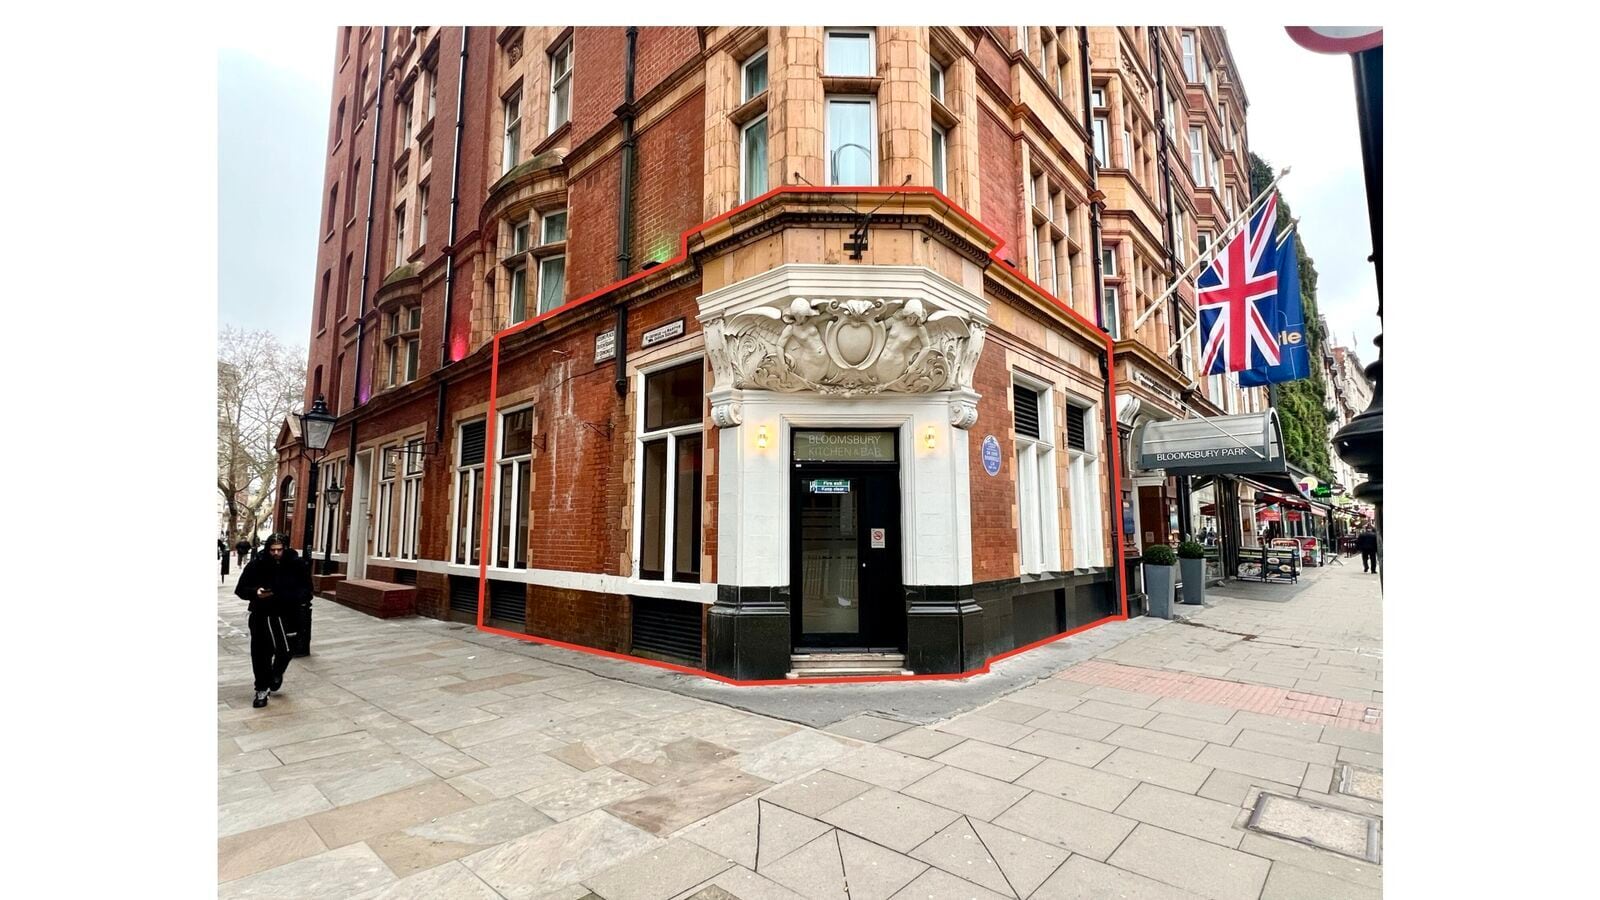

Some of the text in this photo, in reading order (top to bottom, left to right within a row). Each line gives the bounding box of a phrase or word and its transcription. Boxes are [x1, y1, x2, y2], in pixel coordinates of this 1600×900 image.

[808, 435, 880, 444] BLOOMSBURY
[808, 447, 852, 457] KITCHEN
[1156, 447, 1248, 461] BLOOMSBURY PARK
